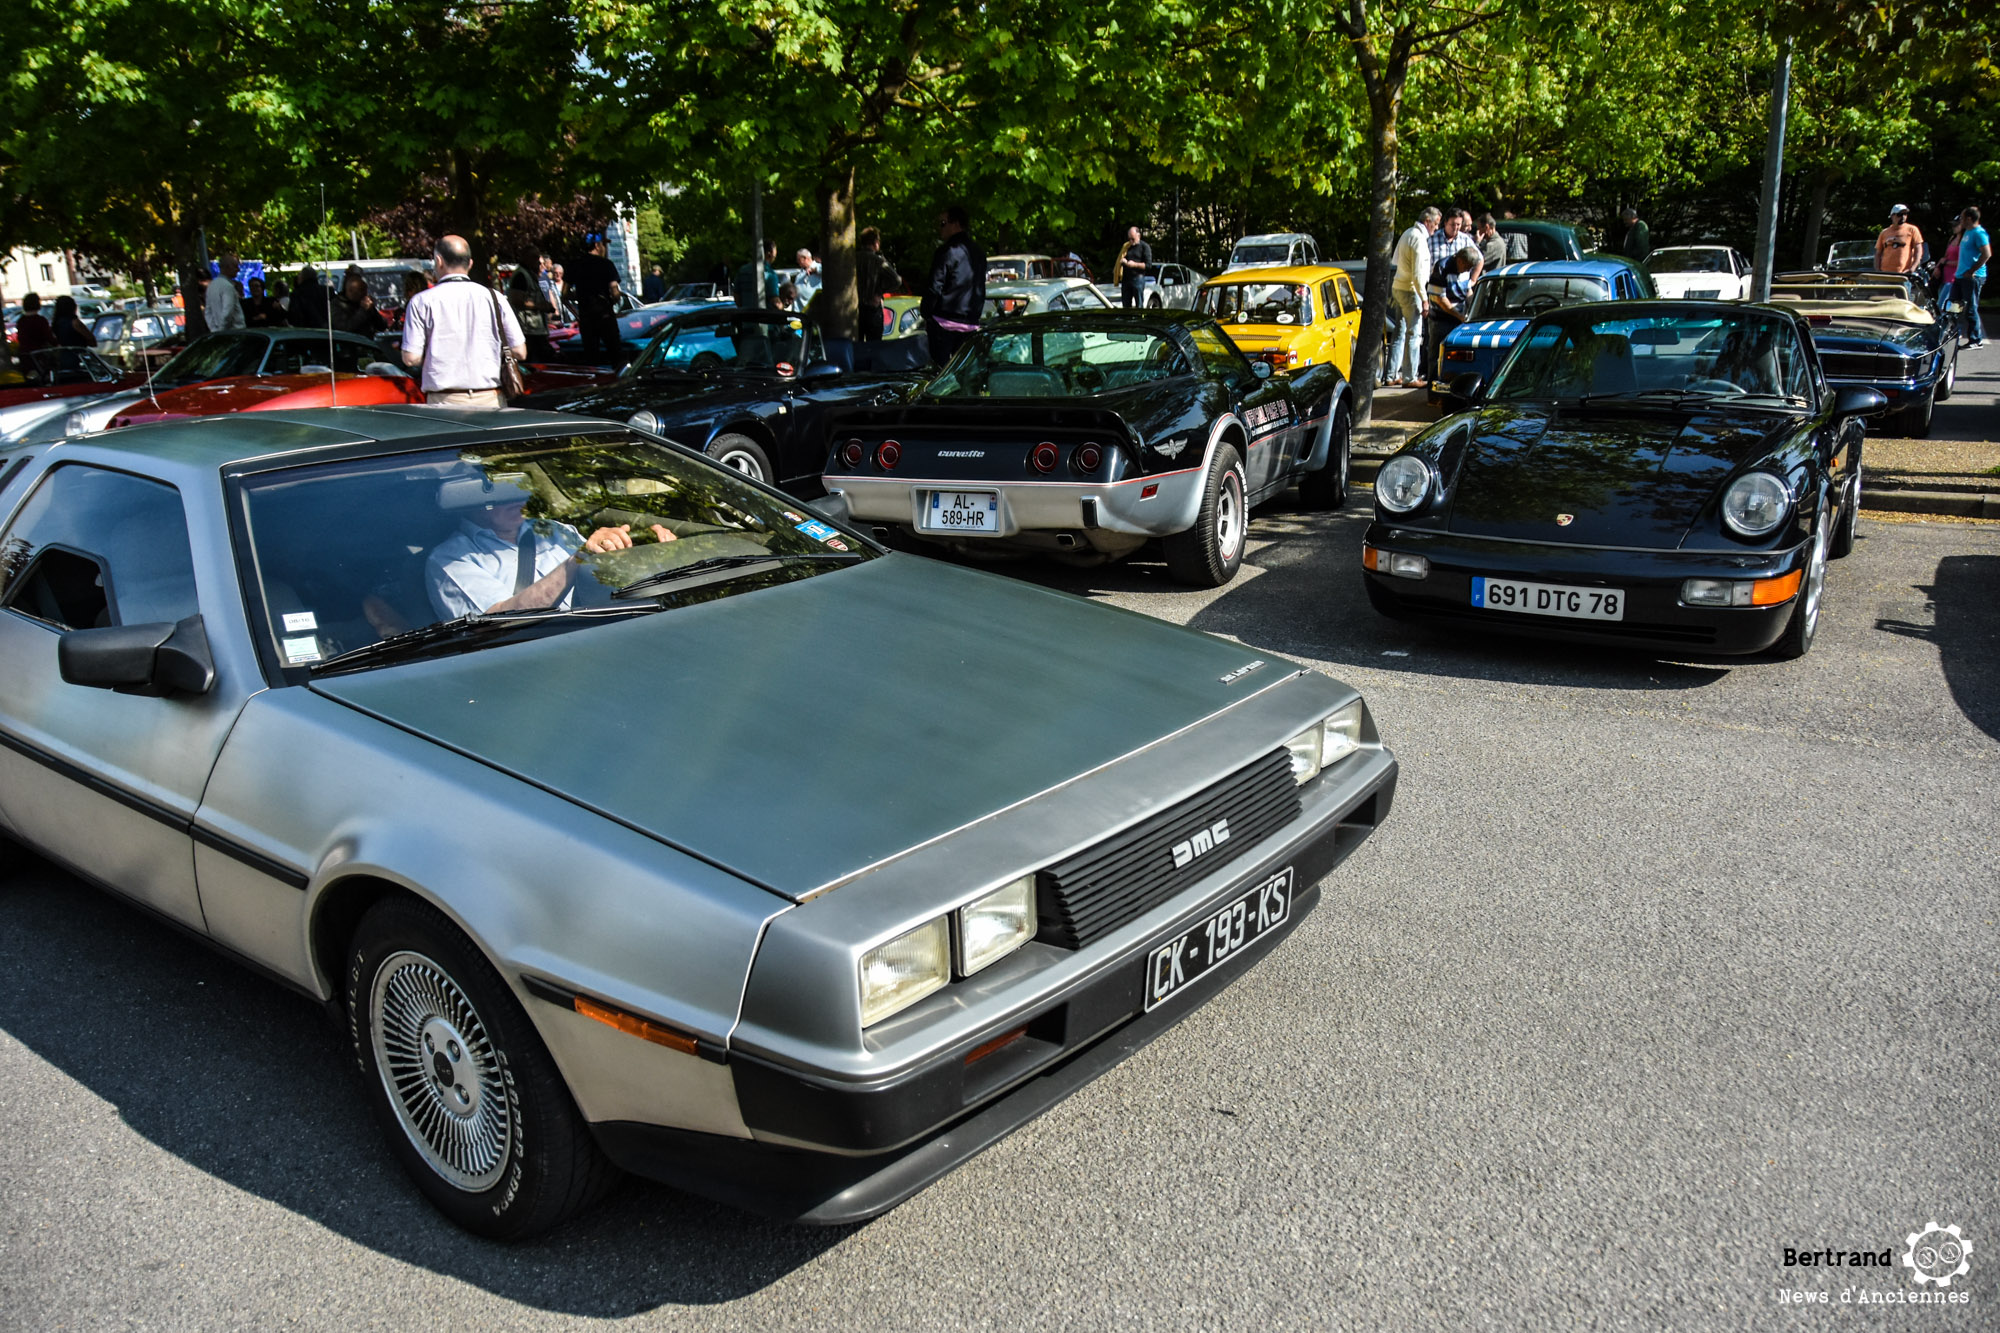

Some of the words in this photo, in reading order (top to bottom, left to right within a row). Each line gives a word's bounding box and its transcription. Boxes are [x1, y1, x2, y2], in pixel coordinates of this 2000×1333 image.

[953, 494, 975, 509] AL-
[942, 510, 985, 526] 589-HR
[1489, 584, 1528, 607] 691
[1537, 588, 1581, 613] DTG
[1589, 592, 1618, 615] 78
[498, 1049, 524, 1159] COOPER
